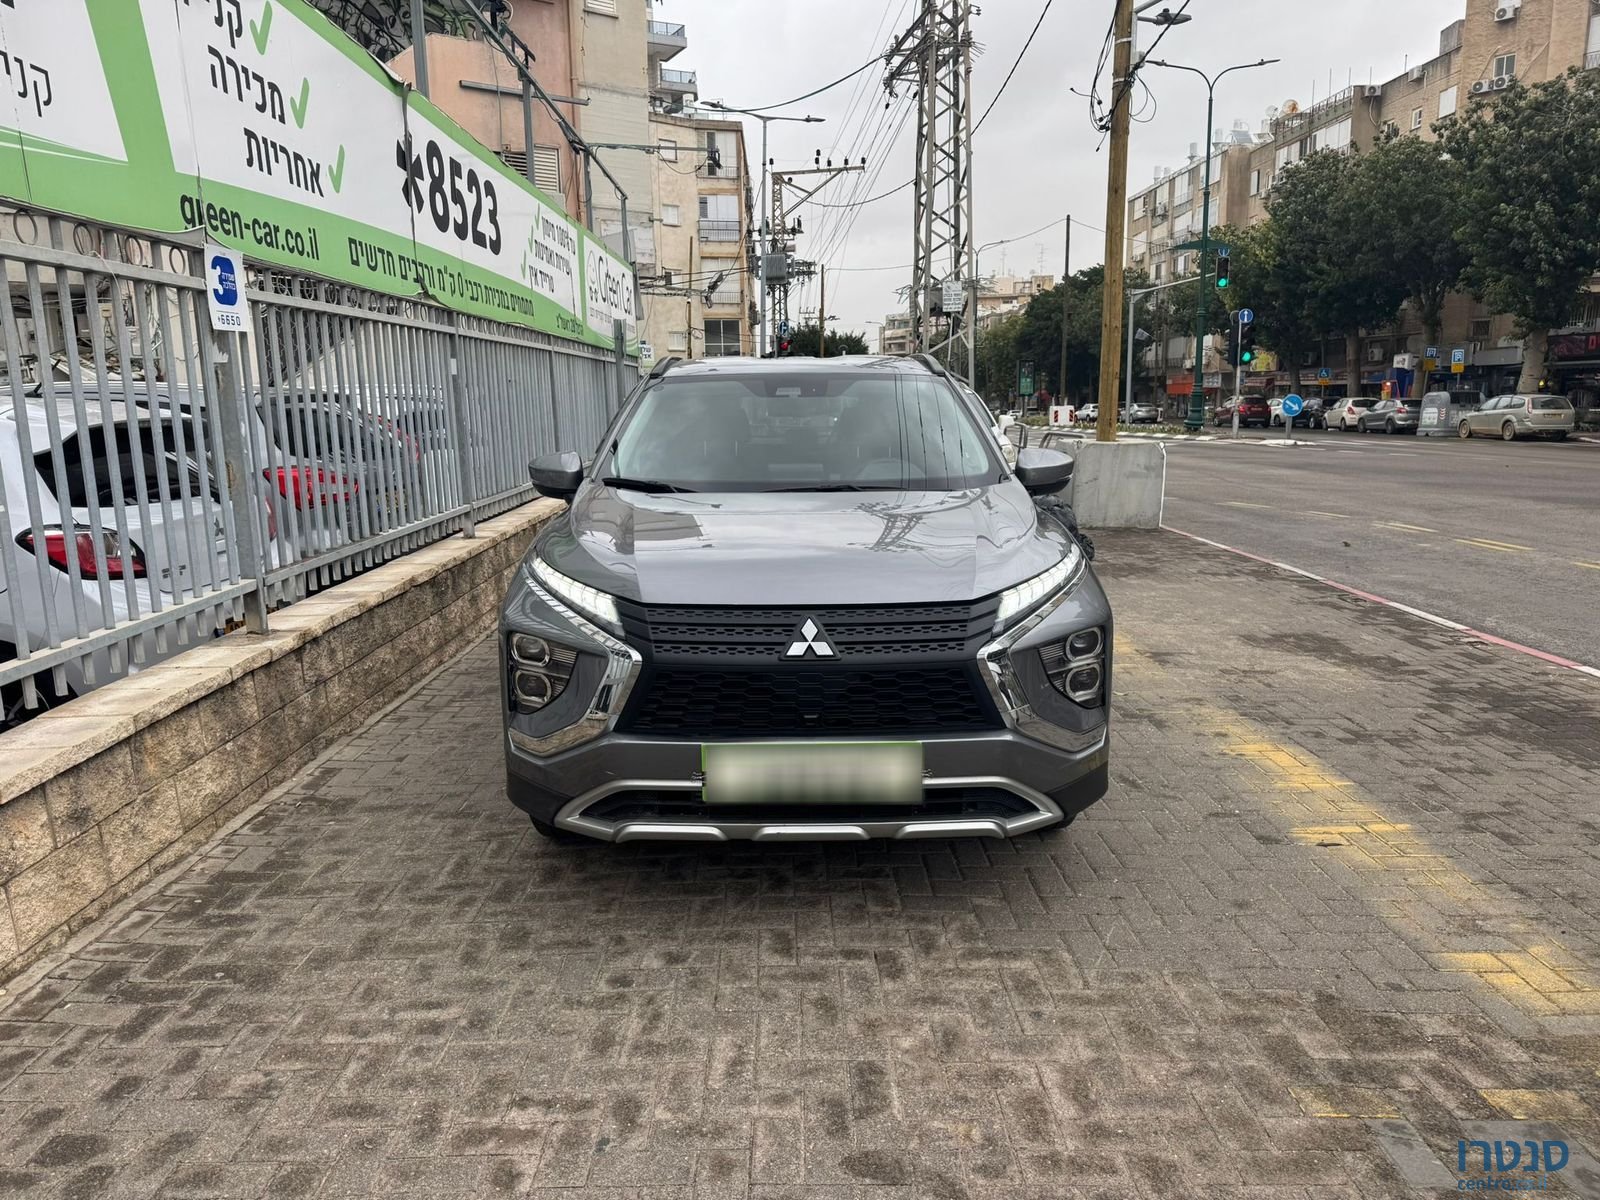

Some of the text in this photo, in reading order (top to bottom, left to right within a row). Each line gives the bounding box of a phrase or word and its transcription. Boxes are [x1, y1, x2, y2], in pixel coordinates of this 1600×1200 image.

[208, 45, 286, 125] מכירה
[243, 126, 324, 198] אחריות
[180, 192, 320, 261] green-car.co.il
[347, 236, 397, 277] חדשים
